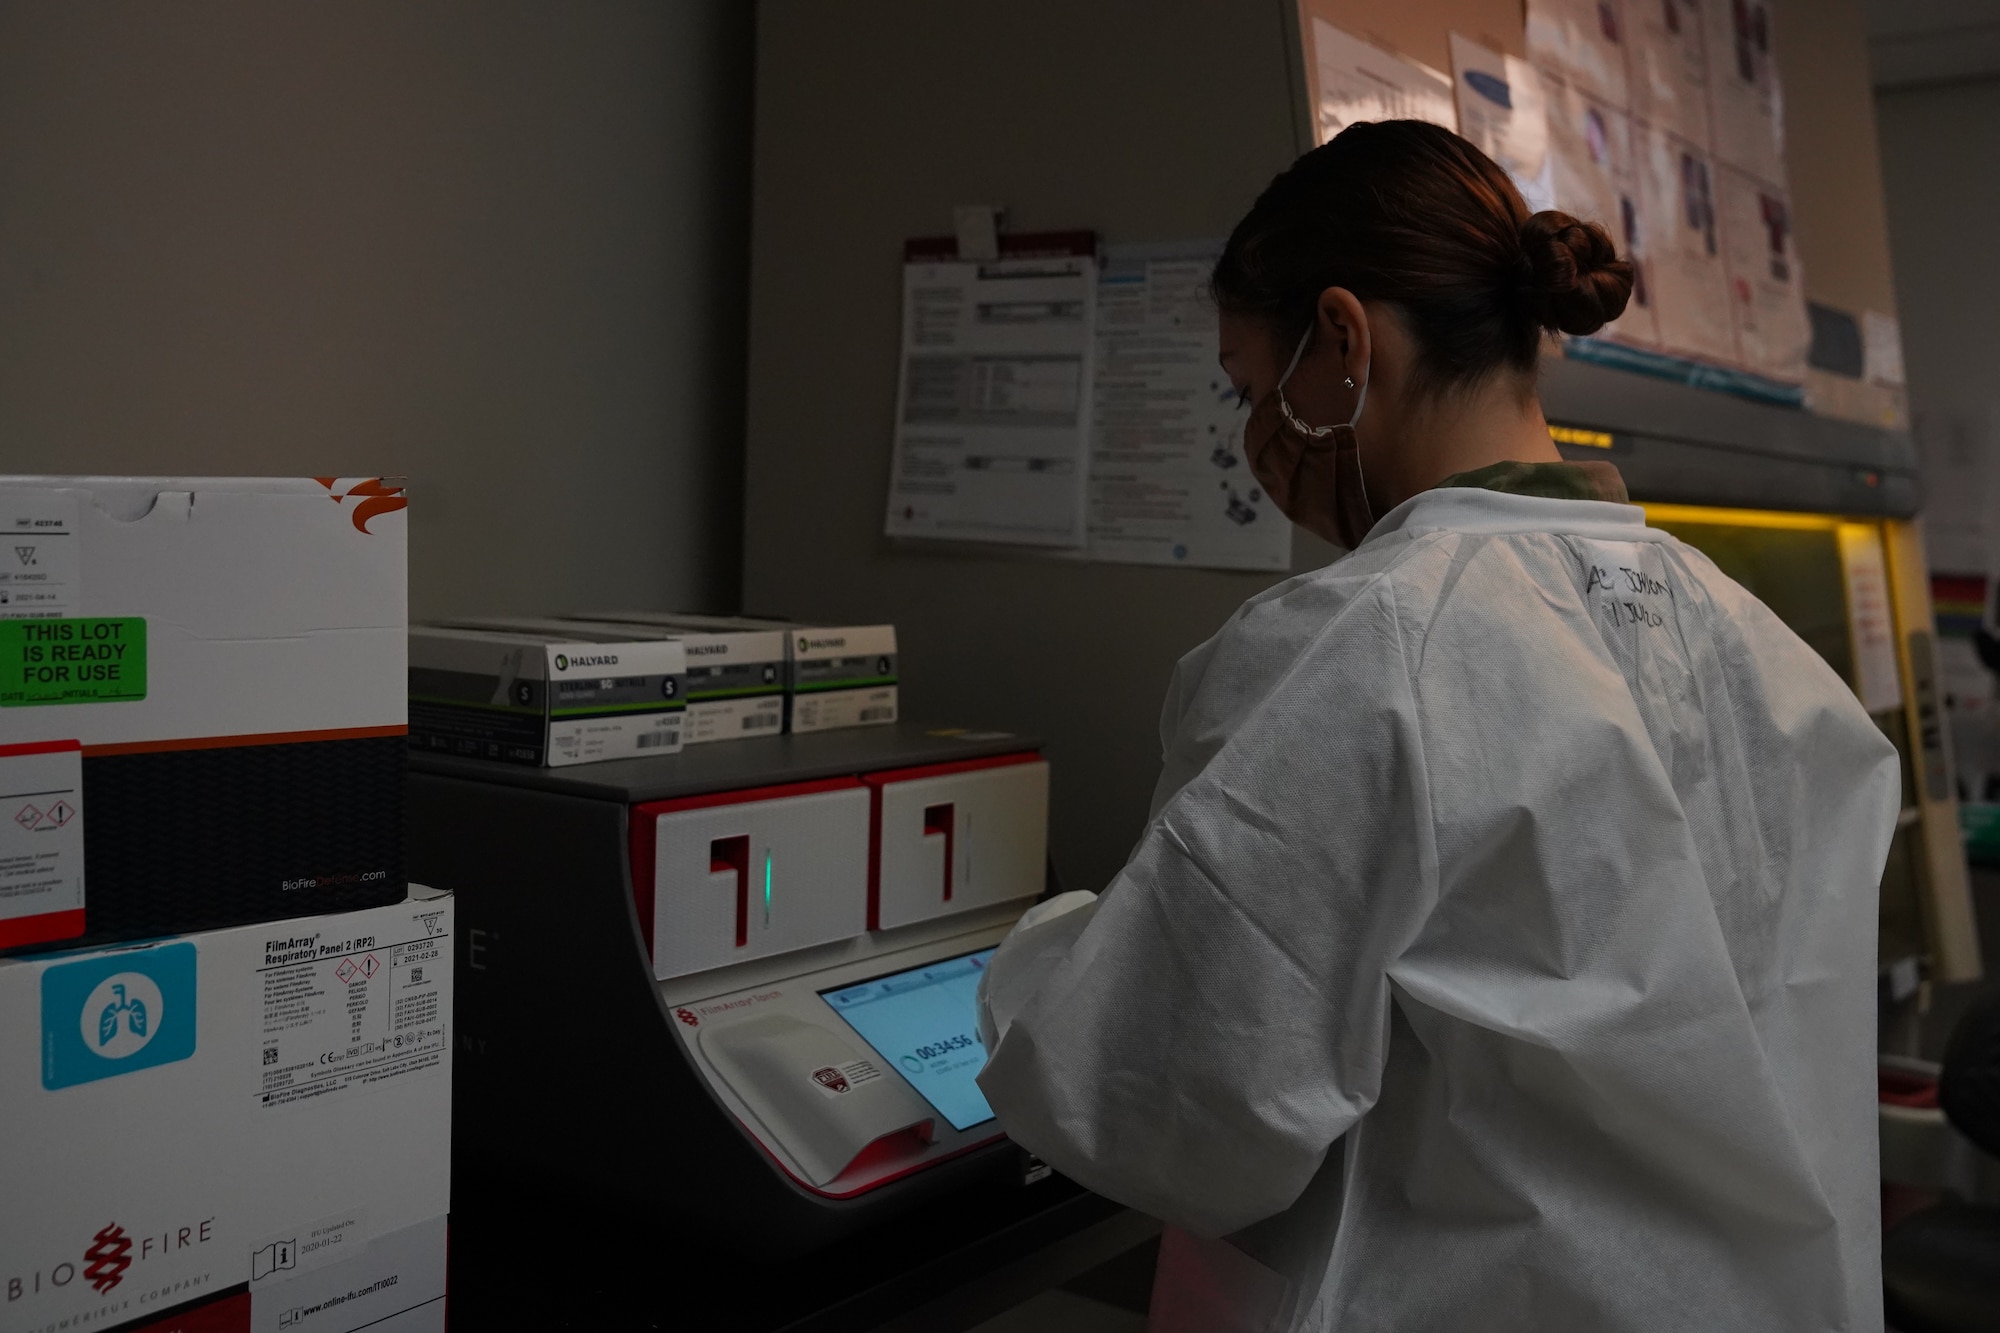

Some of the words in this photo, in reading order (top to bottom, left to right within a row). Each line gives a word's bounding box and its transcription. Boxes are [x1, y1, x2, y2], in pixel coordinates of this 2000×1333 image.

[22, 624, 73, 641] THIS
[81, 623, 123, 640] LOT
[23, 646, 44, 662] IS
[52, 643, 127, 661] READY
[570, 655, 619, 667] HALYARD
[24, 666, 70, 683] FOR
[78, 664, 121, 681] USE
[62, 689, 98, 698] INITIALS
[520, 686, 529, 700] S
[559, 680, 600, 693] STERLING
[601, 678, 614, 690] SG
[615, 678, 646, 689] NITRILE
[665, 681, 675, 695] S
[265, 948, 317, 965] Respiratory
[320, 942, 344, 955] Panel
[345, 940, 351, 951] 2
[353, 936, 375, 950] (RP2)
[408, 941, 434, 952] 0293720
[404, 950, 439, 963] 2021-02-28
[348, 980, 367, 988] DANGER
[348, 986, 367, 995] PELIGRO
[753, 990, 783, 1002] Torch
[916, 1034, 973, 1060] 00:34:56
[310, 1068, 332, 1079] Symbols
[333, 1063, 355, 1074] Glossary
[372, 1055, 386, 1064] found
[392, 1049, 413, 1060] Appendix
[270, 1092, 290, 1101] BioFire
[326, 1079, 337, 1087] LLC
[322, 1222, 345, 1236] Updated
[301, 1233, 343, 1254] 2020-01-22
[7, 1262, 75, 1301] BIO
[139, 1273, 211, 1304] COMPANY
